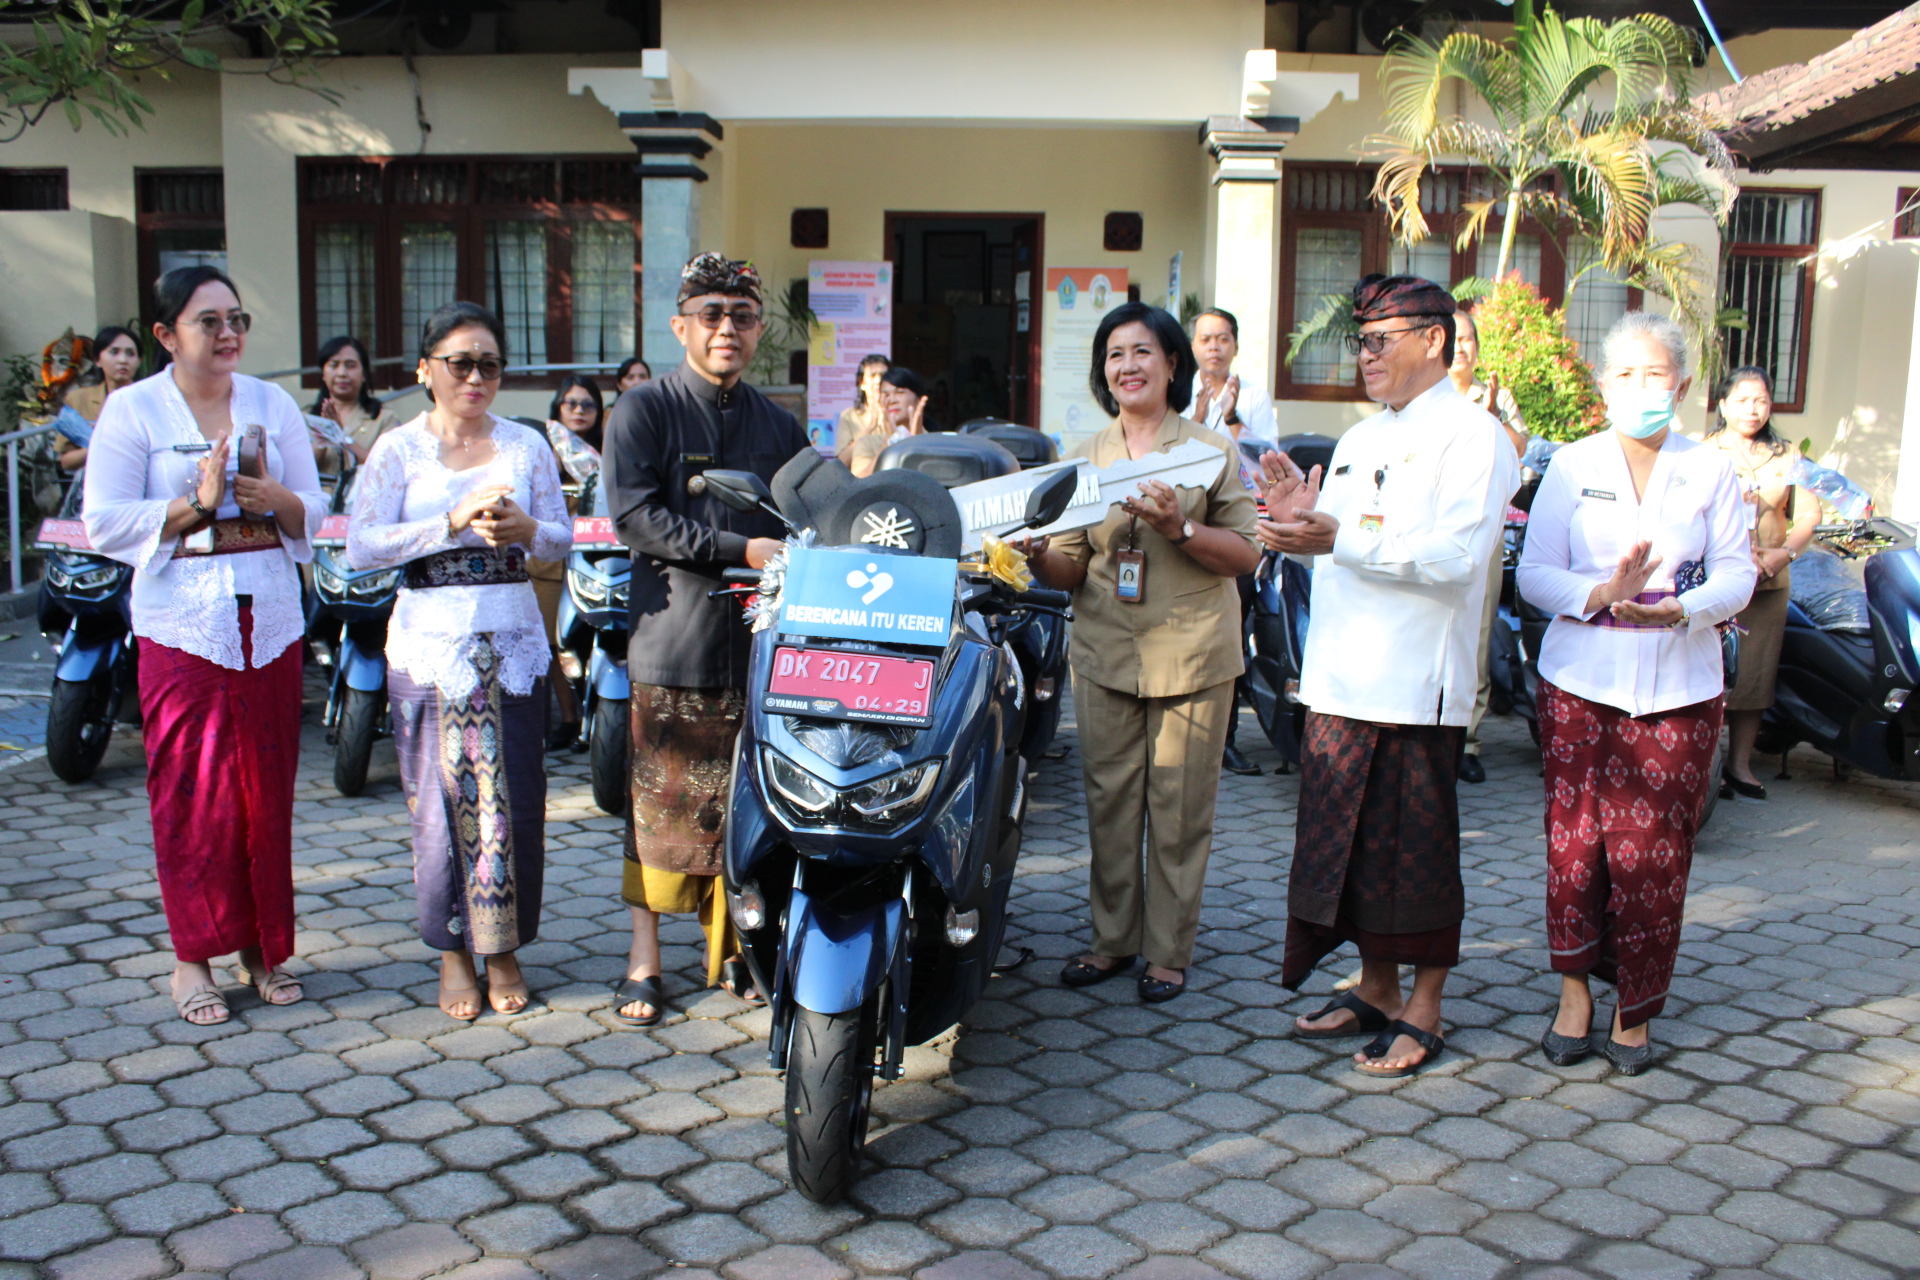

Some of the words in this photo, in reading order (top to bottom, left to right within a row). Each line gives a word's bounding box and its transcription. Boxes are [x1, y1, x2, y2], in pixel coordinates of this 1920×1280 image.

[577, 521, 594, 533] DK
[786, 604, 868, 627] BERENCANA
[870, 611, 895, 629] ITU
[897, 613, 944, 633] KEREN
[779, 654, 811, 678] DK
[819, 657, 881, 685] 2047
[914, 667, 929, 690] J
[775, 698, 808, 710] YAMAHA
[846, 711, 886, 720] SEMAKIN
